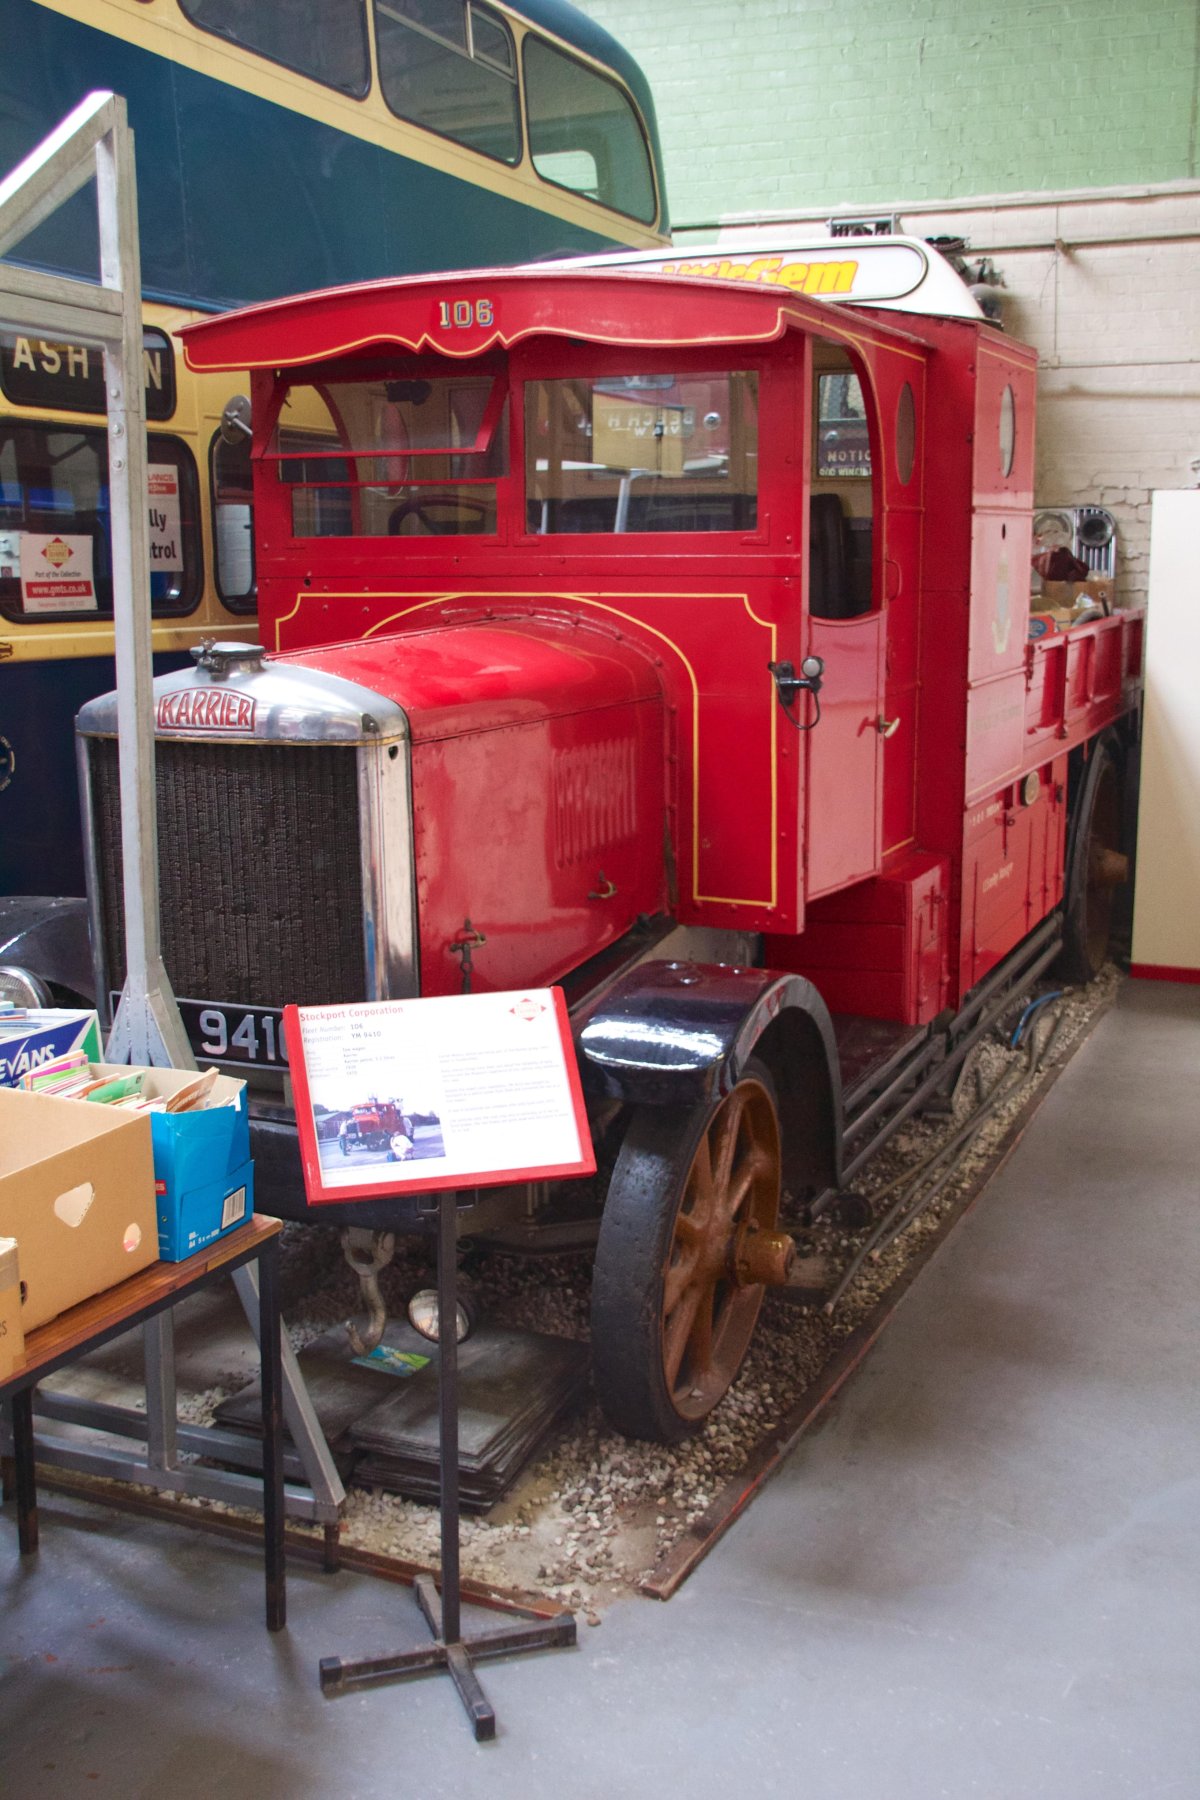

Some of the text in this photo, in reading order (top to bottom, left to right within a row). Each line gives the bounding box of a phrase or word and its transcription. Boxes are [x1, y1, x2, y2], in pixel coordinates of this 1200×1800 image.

[439, 299, 494, 329] 106
[13, 336, 162, 390] ASHN
[150, 540, 177, 559] trol
[32, 583, 87, 597] www.gmts.co.uk
[161, 690, 251, 727] KARRIER
[300, 1005, 405, 1022] Stockport Corporation
[302, 1026, 318, 1035] Fleet
[350, 1023, 364, 1031] 106
[303, 1035, 344, 1044] Registration:
[363, 1030, 382, 1039] 9410
[0, 1038, 55, 1080] EVANS
